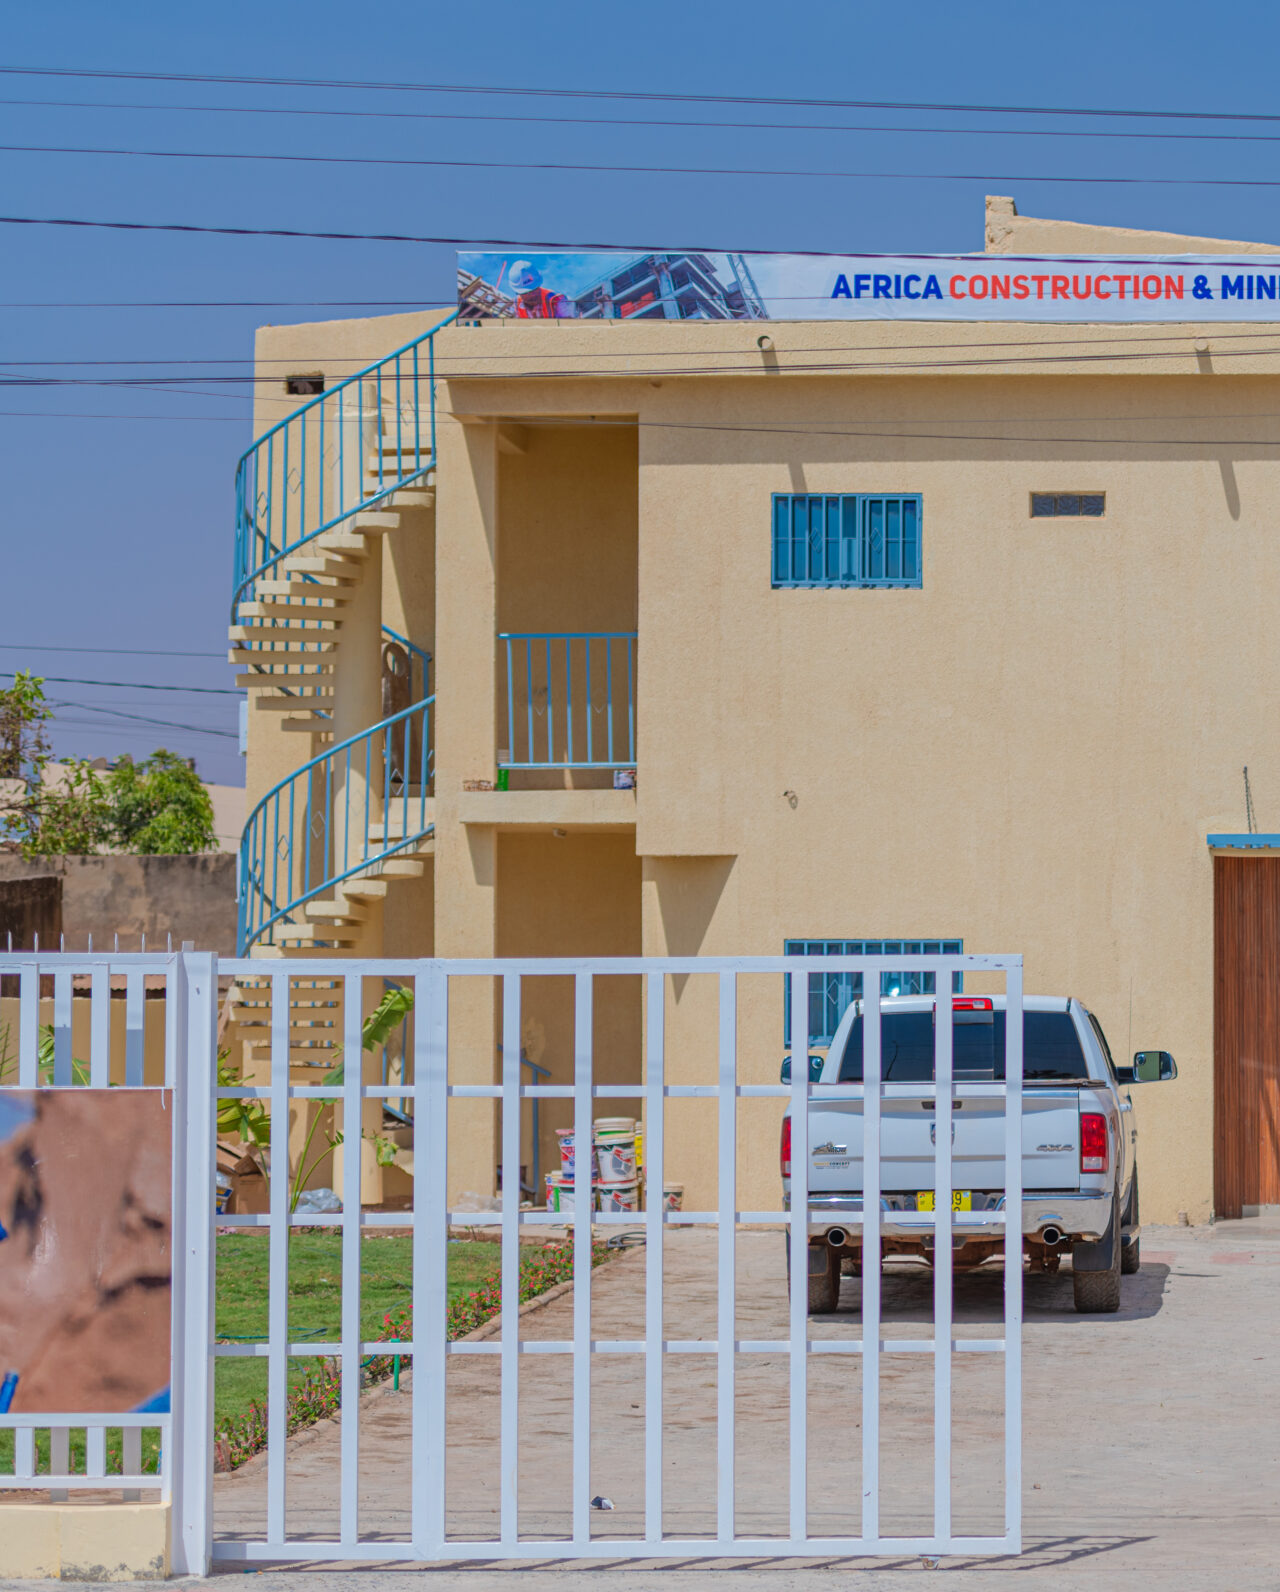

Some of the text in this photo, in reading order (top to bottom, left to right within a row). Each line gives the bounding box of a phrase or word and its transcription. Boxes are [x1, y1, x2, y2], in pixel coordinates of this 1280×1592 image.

[831, 274, 943, 300] AFRICA
[949, 274, 1184, 300] CONSTRUCTION
[1192, 274, 1214, 300] &
